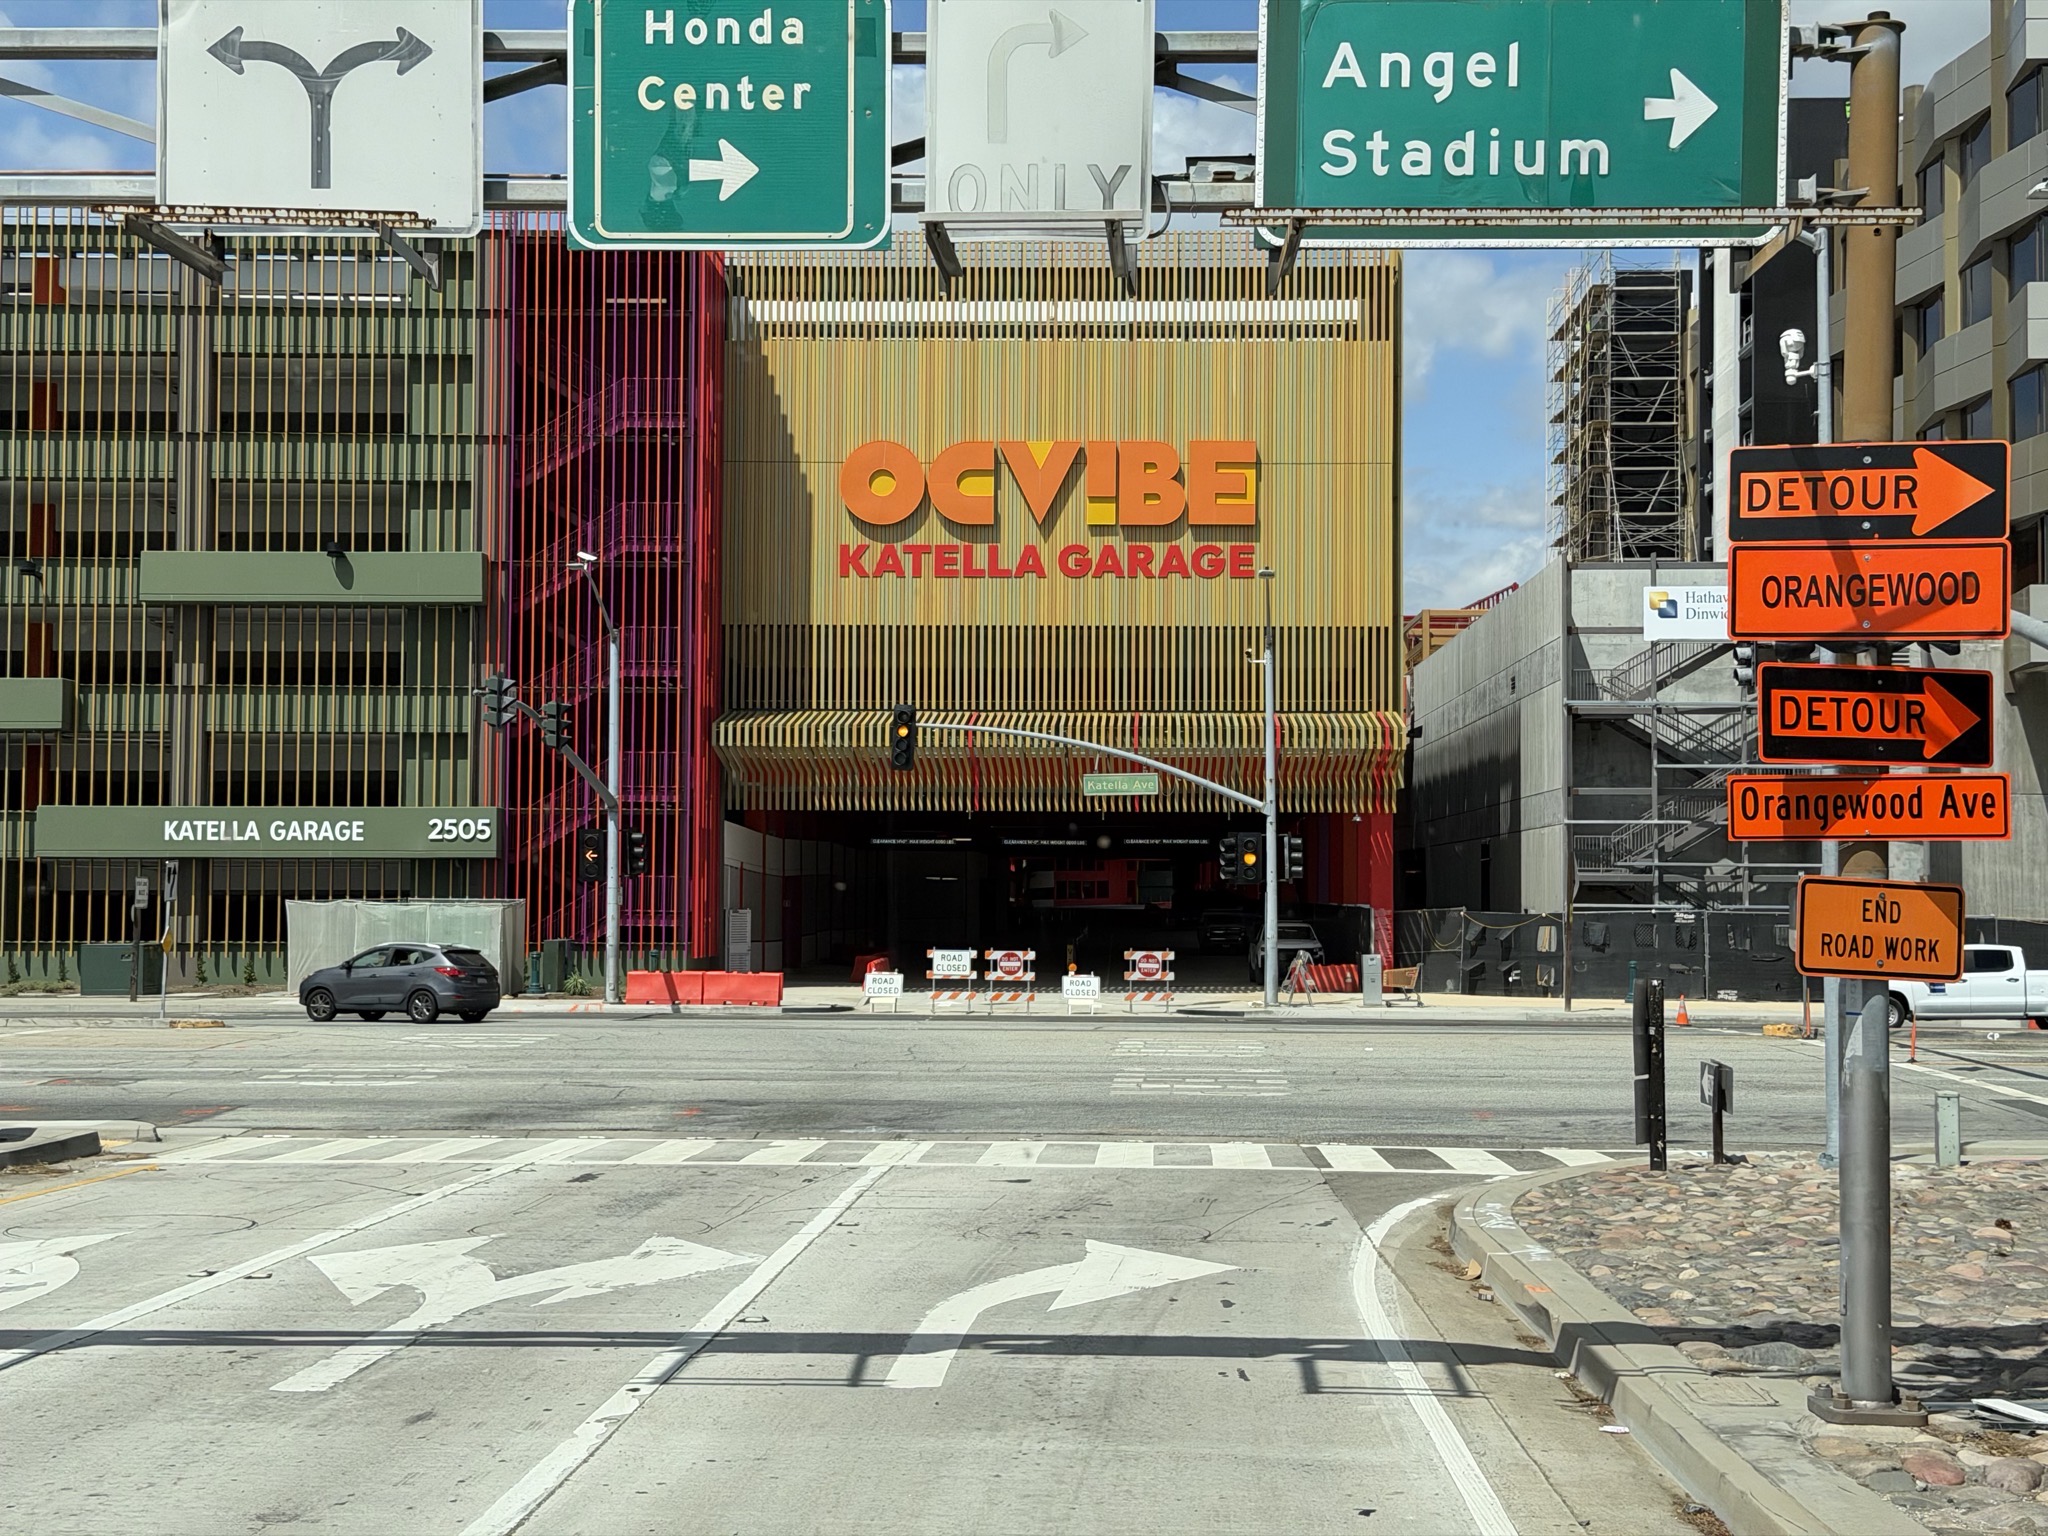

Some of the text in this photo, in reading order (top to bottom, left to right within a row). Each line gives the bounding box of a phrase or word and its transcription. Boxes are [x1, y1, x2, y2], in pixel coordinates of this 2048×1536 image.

[645, 7, 805, 46] Honda
[1321, 41, 1520, 104] Angel
[637, 75, 813, 111] Center
[1320, 127, 1610, 177] Stadium
[947, 163, 1132, 211] ONLY
[1746, 475, 1919, 512] DETOUR
[838, 542, 1256, 579] KATELLA GARAGE
[1761, 571, 1981, 609] ORANGEWOOD
[1779, 695, 1926, 734] DETOUR
[1087, 780, 1154, 790] Katella Ave
[1740, 784, 1996, 832] Orangewood Ave
[163, 820, 366, 841] KATELLA GARAGE
[427, 817, 492, 841] 2505
[1861, 899, 1902, 924] END
[1821, 930, 1941, 964] ROAD WORK
[872, 977, 894, 985] ROAD
[936, 964, 967, 972] CLOSED
[1069, 979, 1092, 987] ROAD
[867, 986, 899, 994] CLOSED
[1065, 988, 1097, 997] CLOSED
